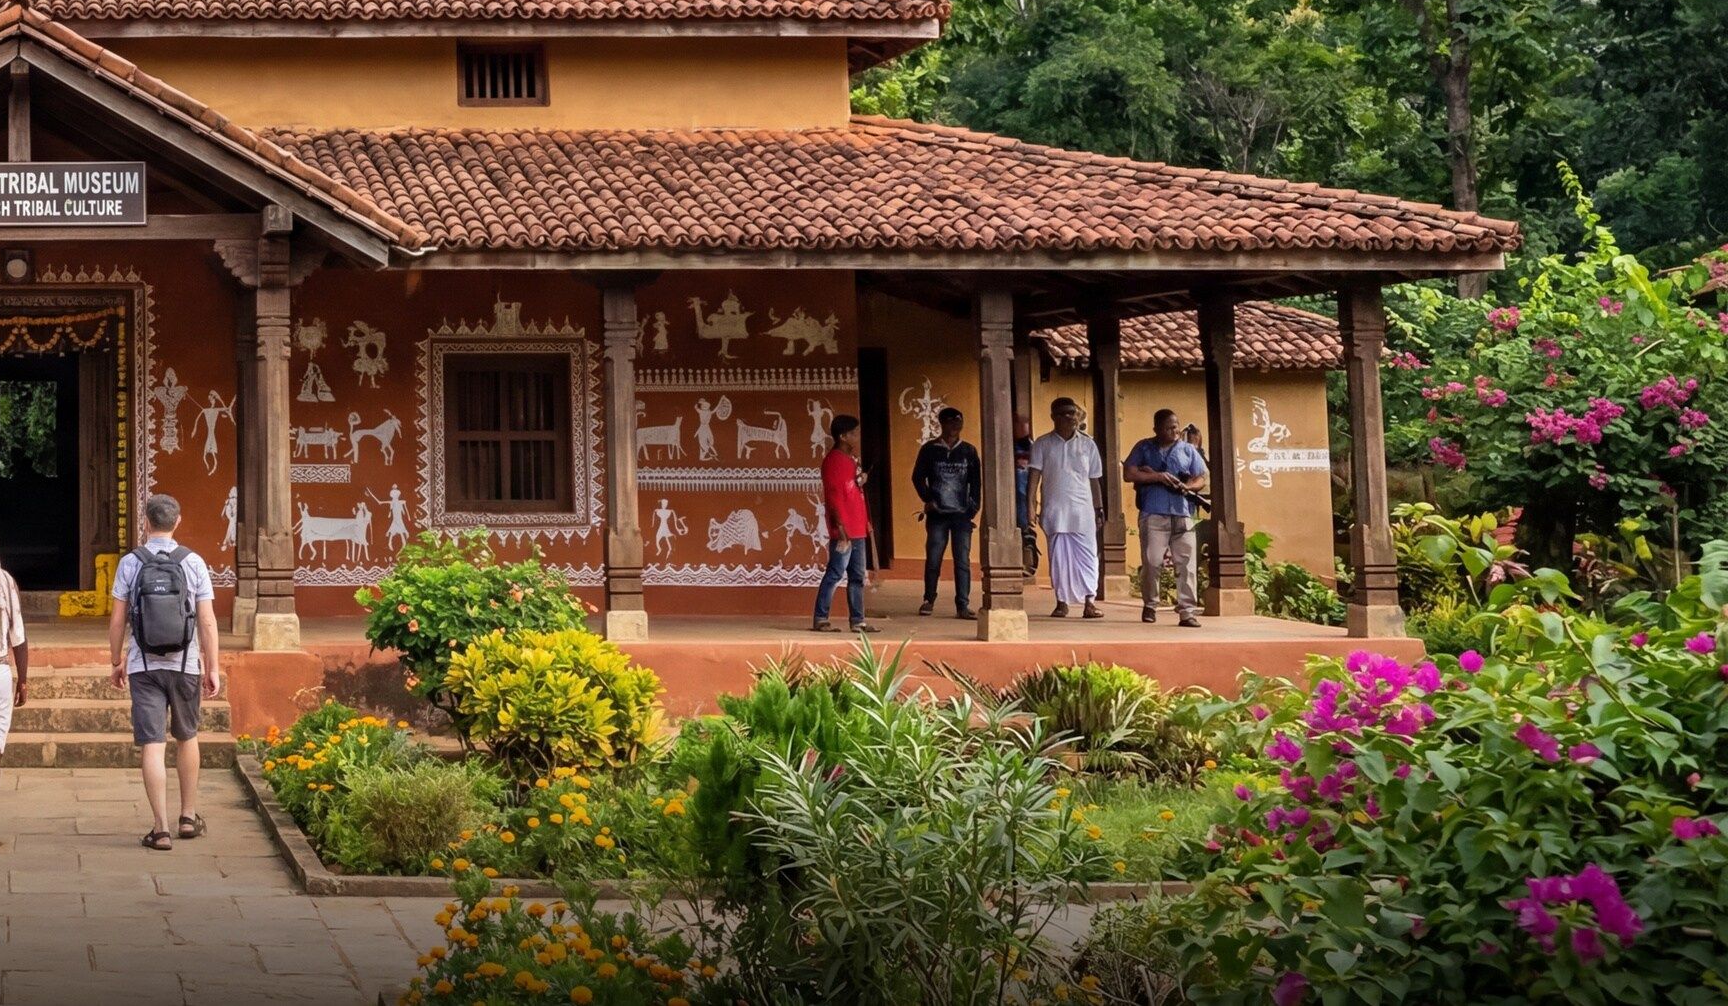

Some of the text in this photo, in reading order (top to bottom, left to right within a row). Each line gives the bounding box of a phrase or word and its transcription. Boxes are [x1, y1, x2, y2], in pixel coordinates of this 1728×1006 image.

[64, 171, 139, 194] MUSEUM
[14, 200, 60, 216] TRIBAL
[64, 198, 123, 216] CULTURE
